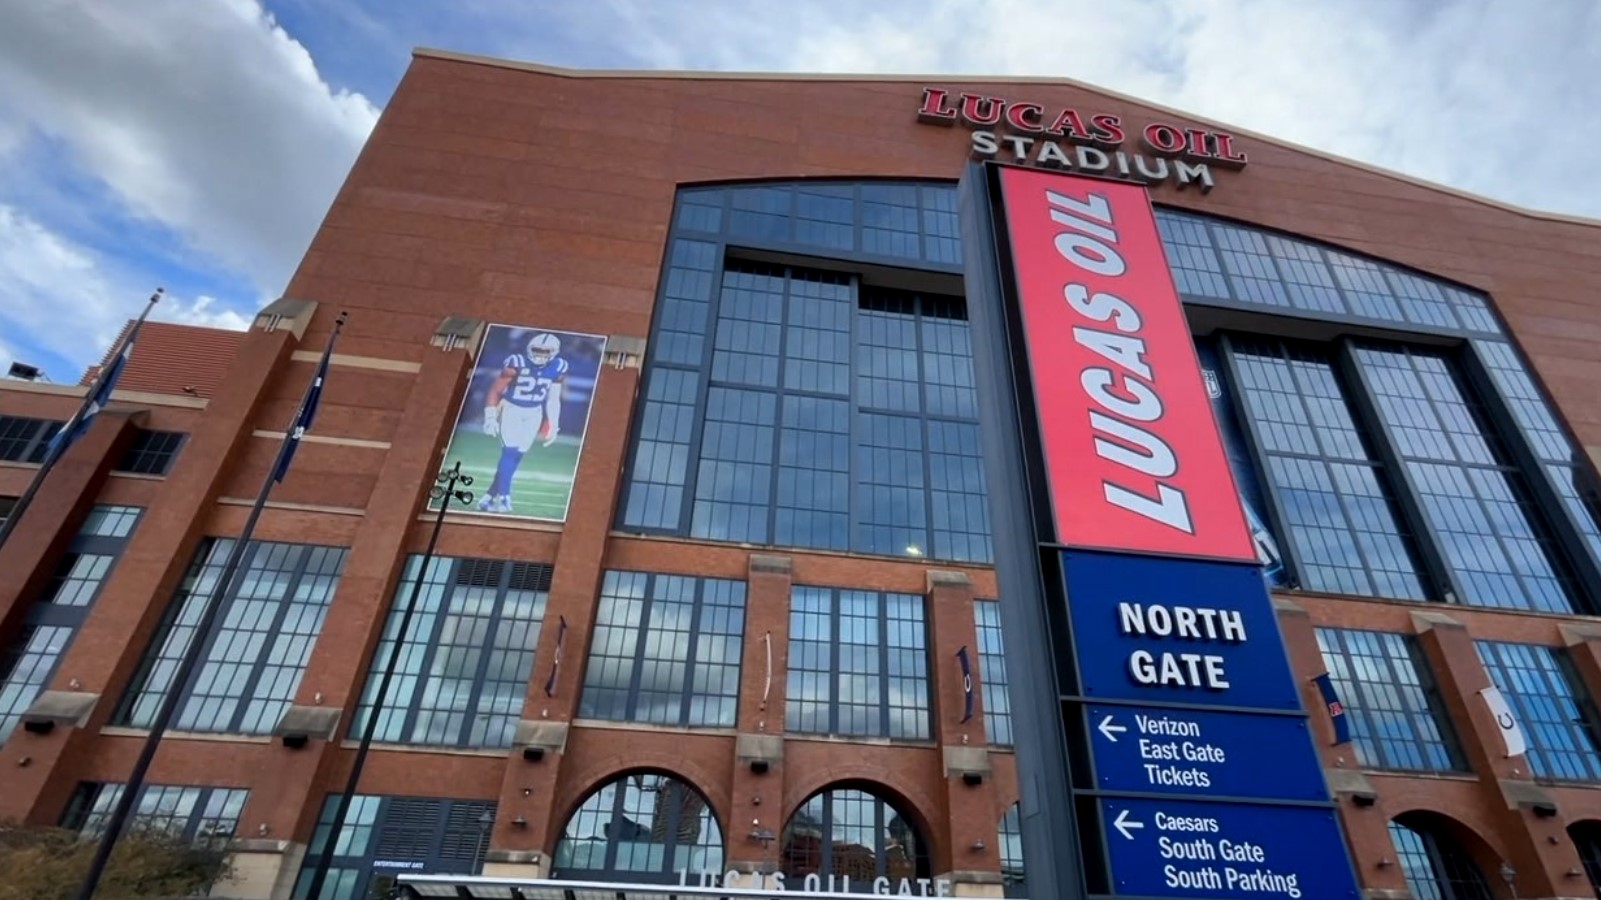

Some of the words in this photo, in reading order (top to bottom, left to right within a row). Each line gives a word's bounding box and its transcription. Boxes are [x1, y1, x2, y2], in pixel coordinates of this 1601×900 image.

[920, 87, 1125, 145] LUCAS
[1143, 122, 1248, 165] OIL
[970, 130, 1215, 190] STADIUM
[1045, 187, 1128, 278] OIL
[512, 376, 552, 402] 23
[1063, 281, 1197, 536] LUCAS
[1119, 602, 1247, 642] NORTH
[1129, 650, 1230, 690] GATE
[1135, 714, 1201, 737] Verizon
[1138, 739, 1181, 761] East
[1182, 741, 1225, 763] Gate
[1144, 763, 1211, 787] Tickets
[1155, 811, 1219, 833] Caesars
[1158, 836, 1216, 861] South
[1219, 839, 1265, 863] Gate
[873, 875, 951, 897] GATE
[1164, 864, 1223, 890] South
[1225, 866, 1301, 899] Parking
